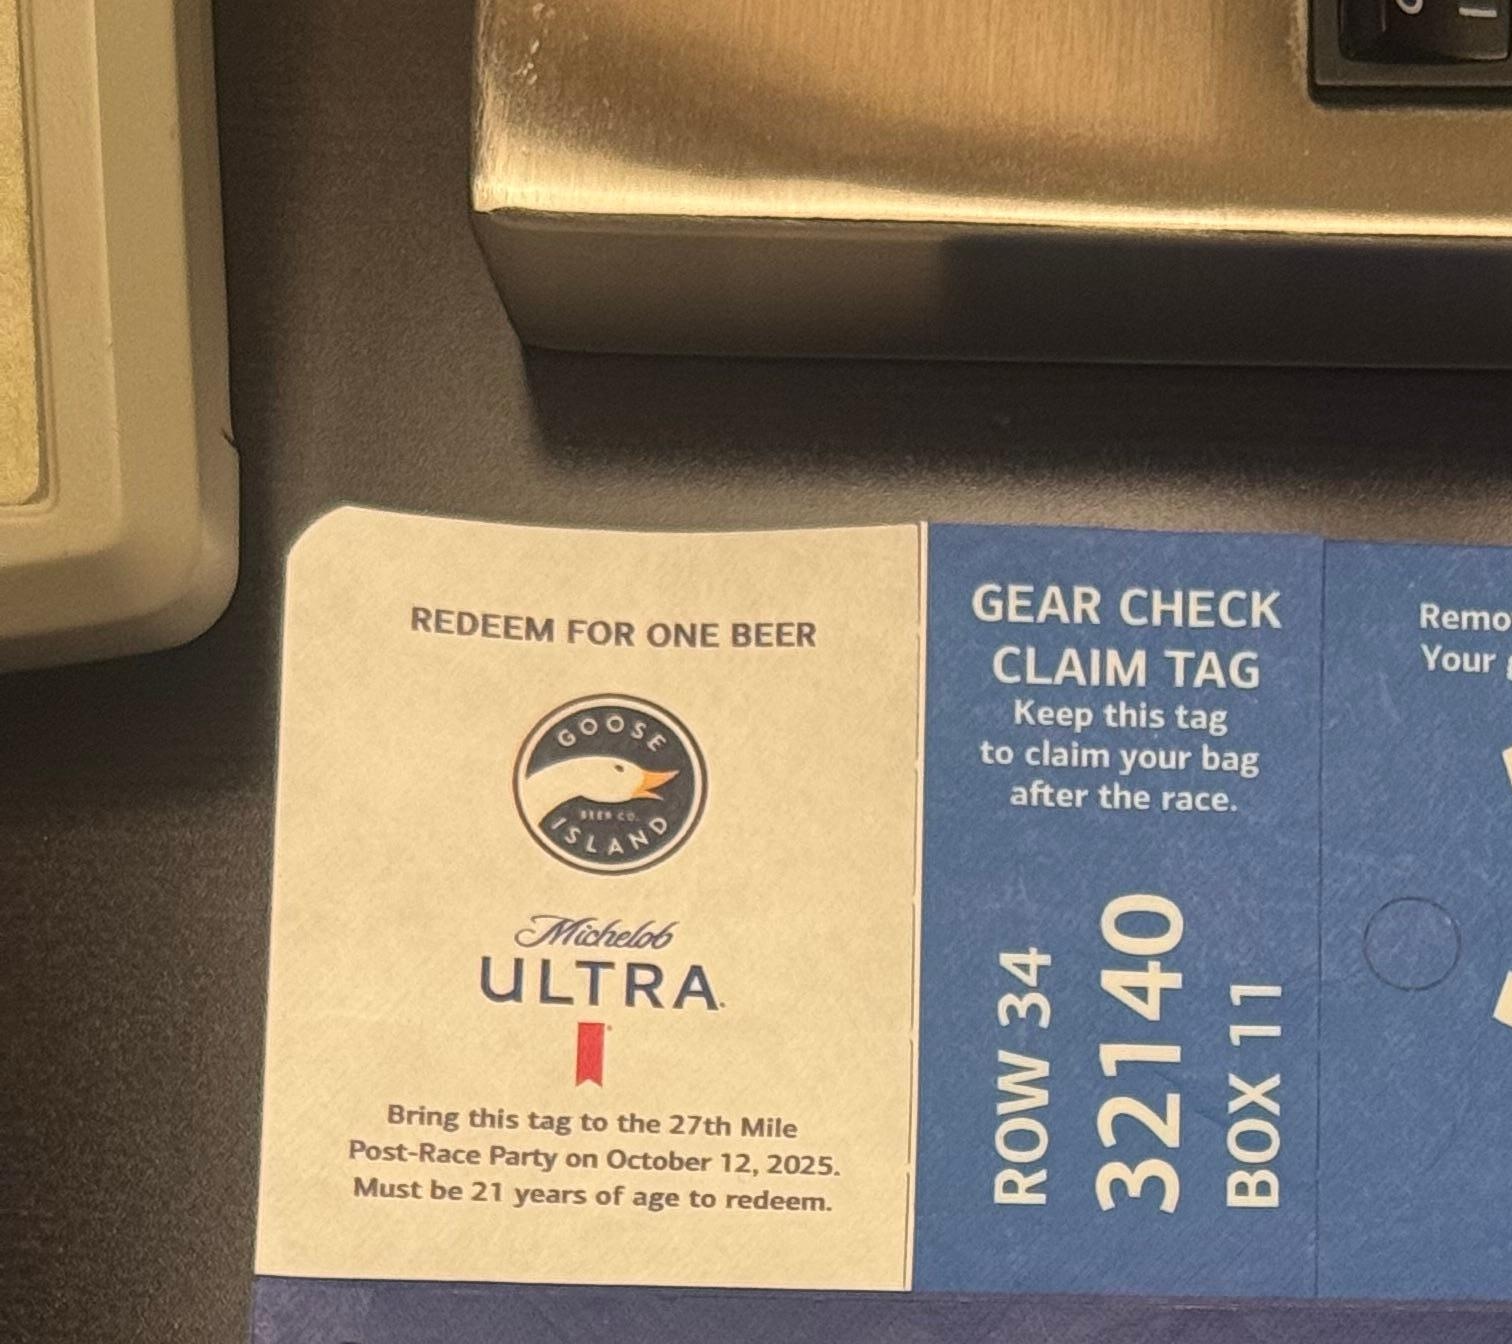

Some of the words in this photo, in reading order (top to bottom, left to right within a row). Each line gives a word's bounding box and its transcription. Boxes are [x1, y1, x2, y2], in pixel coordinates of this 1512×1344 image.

[971, 583, 1101, 625] GEAR
[1119, 587, 1282, 629] CHECK
[410, 606, 555, 643] REDEEM
[567, 619, 635, 647] FOR
[646, 622, 720, 648] ONE
[731, 621, 817, 648] BEER
[992, 645, 1146, 687] CLAIM
[1164, 649, 1260, 689] TAG
[1420, 643, 1497, 673] Your
[558, 715, 667, 751] GOOSE
[1014, 699, 1094, 734] Keep
[1102, 700, 1165, 729] this
[1174, 704, 1228, 737] tag
[979, 740, 1014, 765] to
[1024, 738, 1110, 768] claim
[1119, 748, 1193, 776] your
[1201, 743, 1260, 779] bag
[1009, 779, 1089, 808] after
[1097, 781, 1151, 810] the
[1161, 791, 1238, 812] race.
[552, 817, 667, 855] ISLAND
[513, 914, 679, 950] Michelob
[480, 955, 719, 1011] ULTRA
[997, 946, 1052, 1029] 34
[1229, 984, 1282, 1046] 11
[1095, 893, 1184, 1213] 32140
[387, 1103, 460, 1133] Bring
[468, 1107, 520, 1130] this
[527, 1111, 572, 1137] tag
[579, 1113, 609, 1132] to
[616, 1112, 661, 1134] the
[668, 1114, 732, 1137] 27th
[740, 1116, 798, 1139] Mile
[993, 1049, 1050, 1205] ROW
[1226, 1072, 1281, 1208] BOX
[348, 1139, 482, 1165] Post-Race
[489, 1144, 559, 1173] Party
[565, 1152, 598, 1169] on
[606, 1148, 713, 1172] October
[720, 1152, 759, 1178] 12,
[766, 1153, 841, 1177] 2025.
[353, 1176, 423, 1200] Must
[429, 1178, 463, 1201] be
[470, 1181, 502, 1202] 21
[513, 1187, 588, 1209] years
[595, 1185, 626, 1206] of
[632, 1191, 680, 1213] age
[688, 1189, 717, 1209] to
[725, 1189, 833, 1212] redeem.
